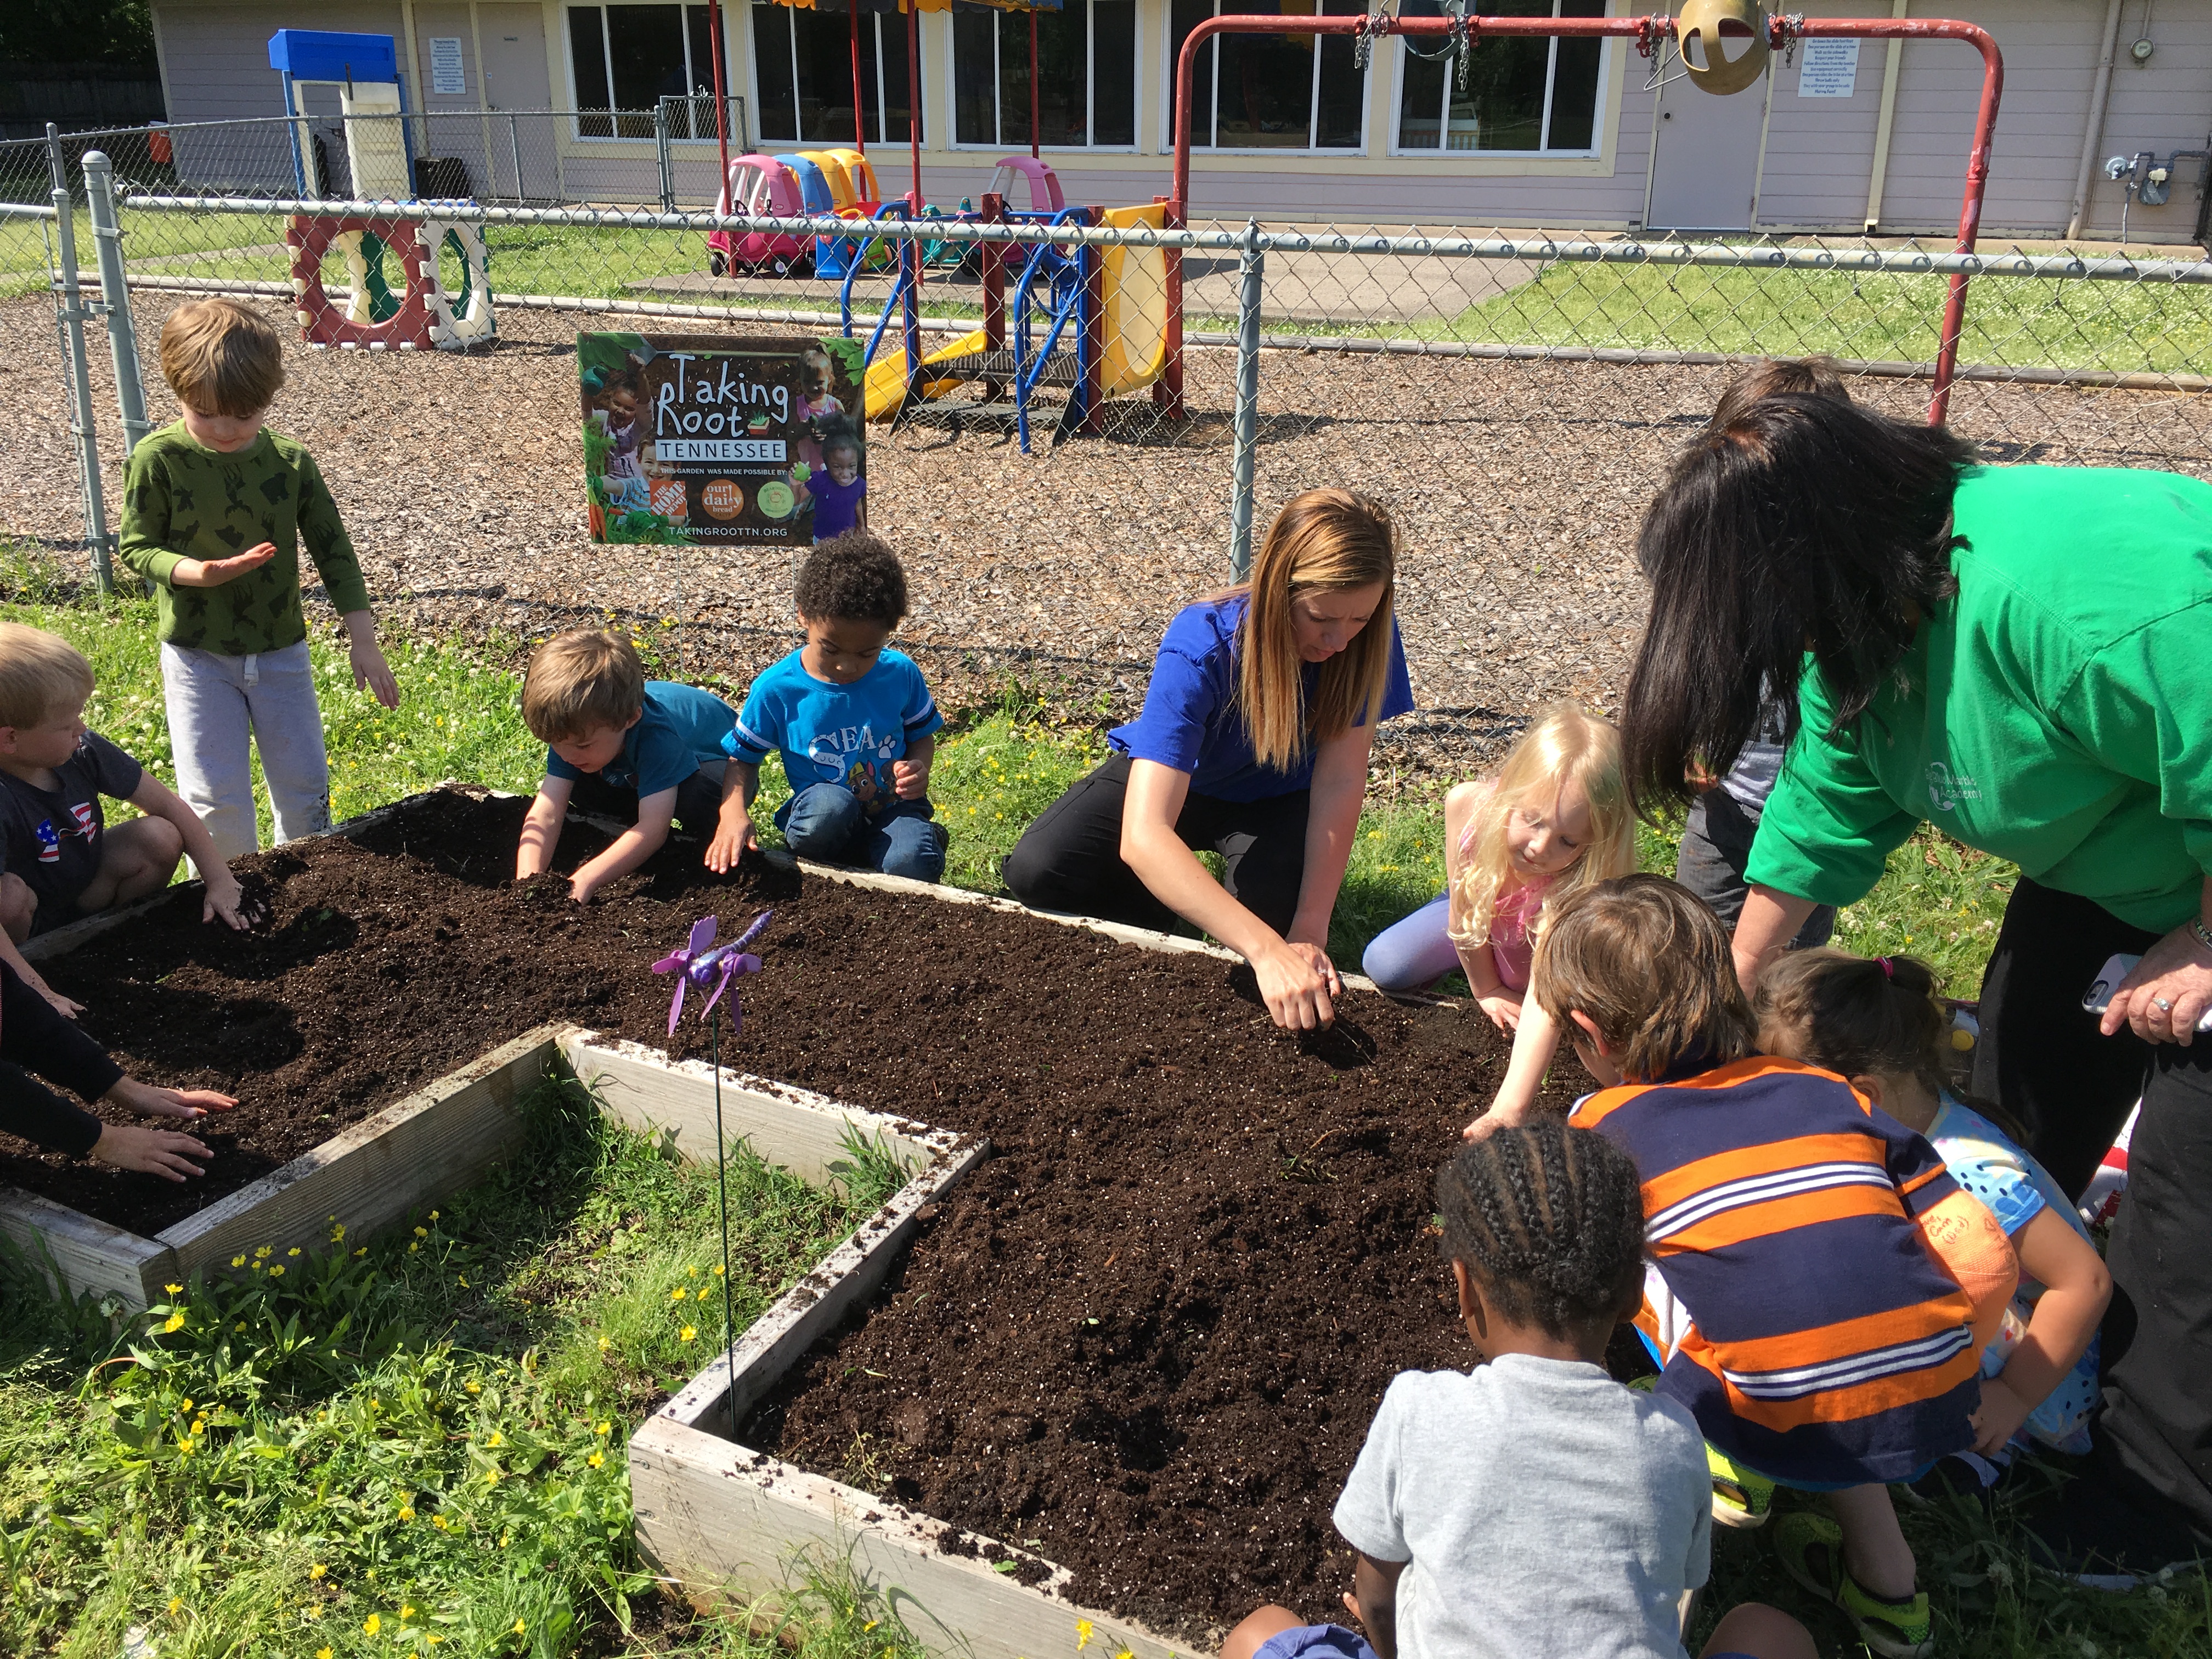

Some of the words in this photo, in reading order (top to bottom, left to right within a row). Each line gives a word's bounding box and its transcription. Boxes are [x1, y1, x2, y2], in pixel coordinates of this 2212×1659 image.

[669, 354, 788, 424] Taking
[657, 382, 744, 437] Root
[660, 443, 782, 458] TENNESSEE
[651, 481, 686, 516] HOME
[653, 484, 668, 498] THE
[704, 485, 742, 508] daily
[665, 494, 686, 516] DEPOT
[669, 527, 787, 536] TAKINGROOTTN.ORG
[809, 726, 877, 783] SEA
[1946, 774, 1977, 786] Marble
[1940, 786, 1982, 802] Academy
